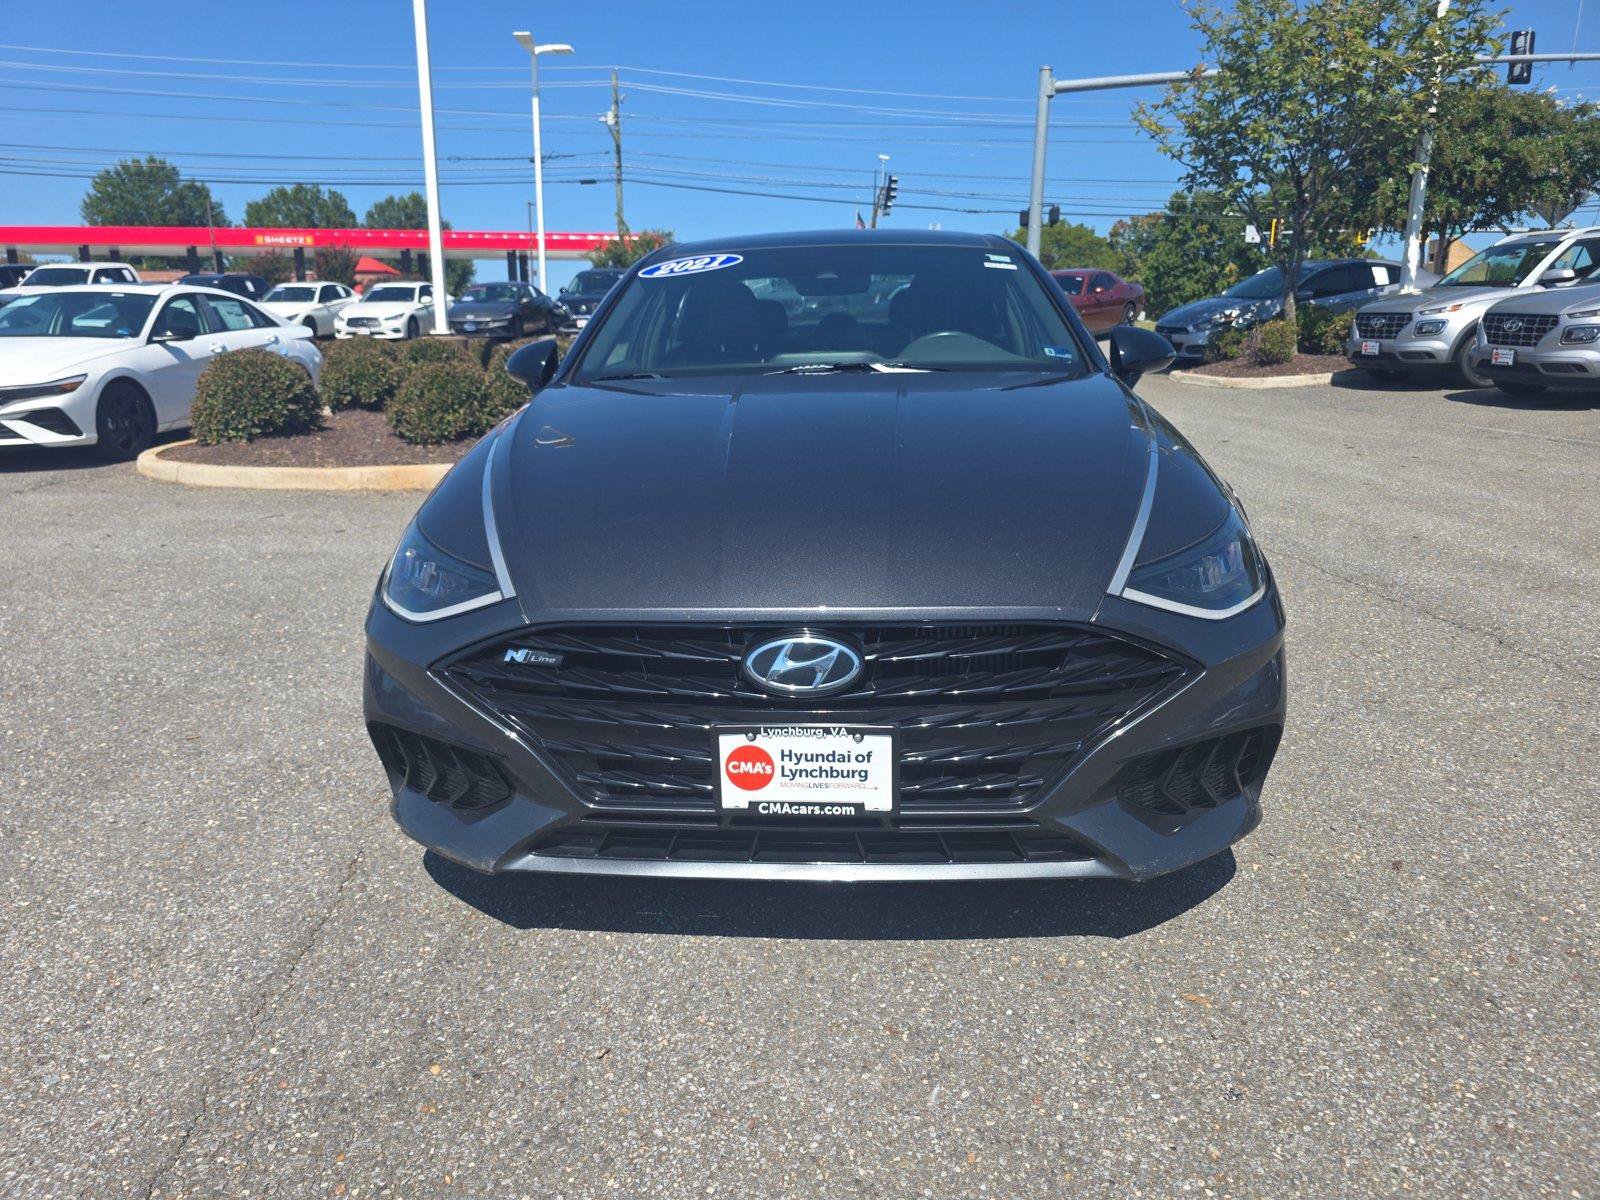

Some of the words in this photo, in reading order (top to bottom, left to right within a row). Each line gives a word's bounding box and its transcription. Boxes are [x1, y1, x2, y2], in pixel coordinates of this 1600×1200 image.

[653, 255, 728, 276] 2021
[504, 649, 528, 662] N
[531, 655, 556, 664] Line
[760, 726, 827, 738] Lynchburg,
[830, 727, 848, 737] VA
[780, 749, 852, 764] Hyundai
[854, 751, 873, 763] of
[728, 761, 773, 774] CMA's
[780, 766, 869, 781] Lynchburg
[758, 802, 855, 815] CMAcars.com
